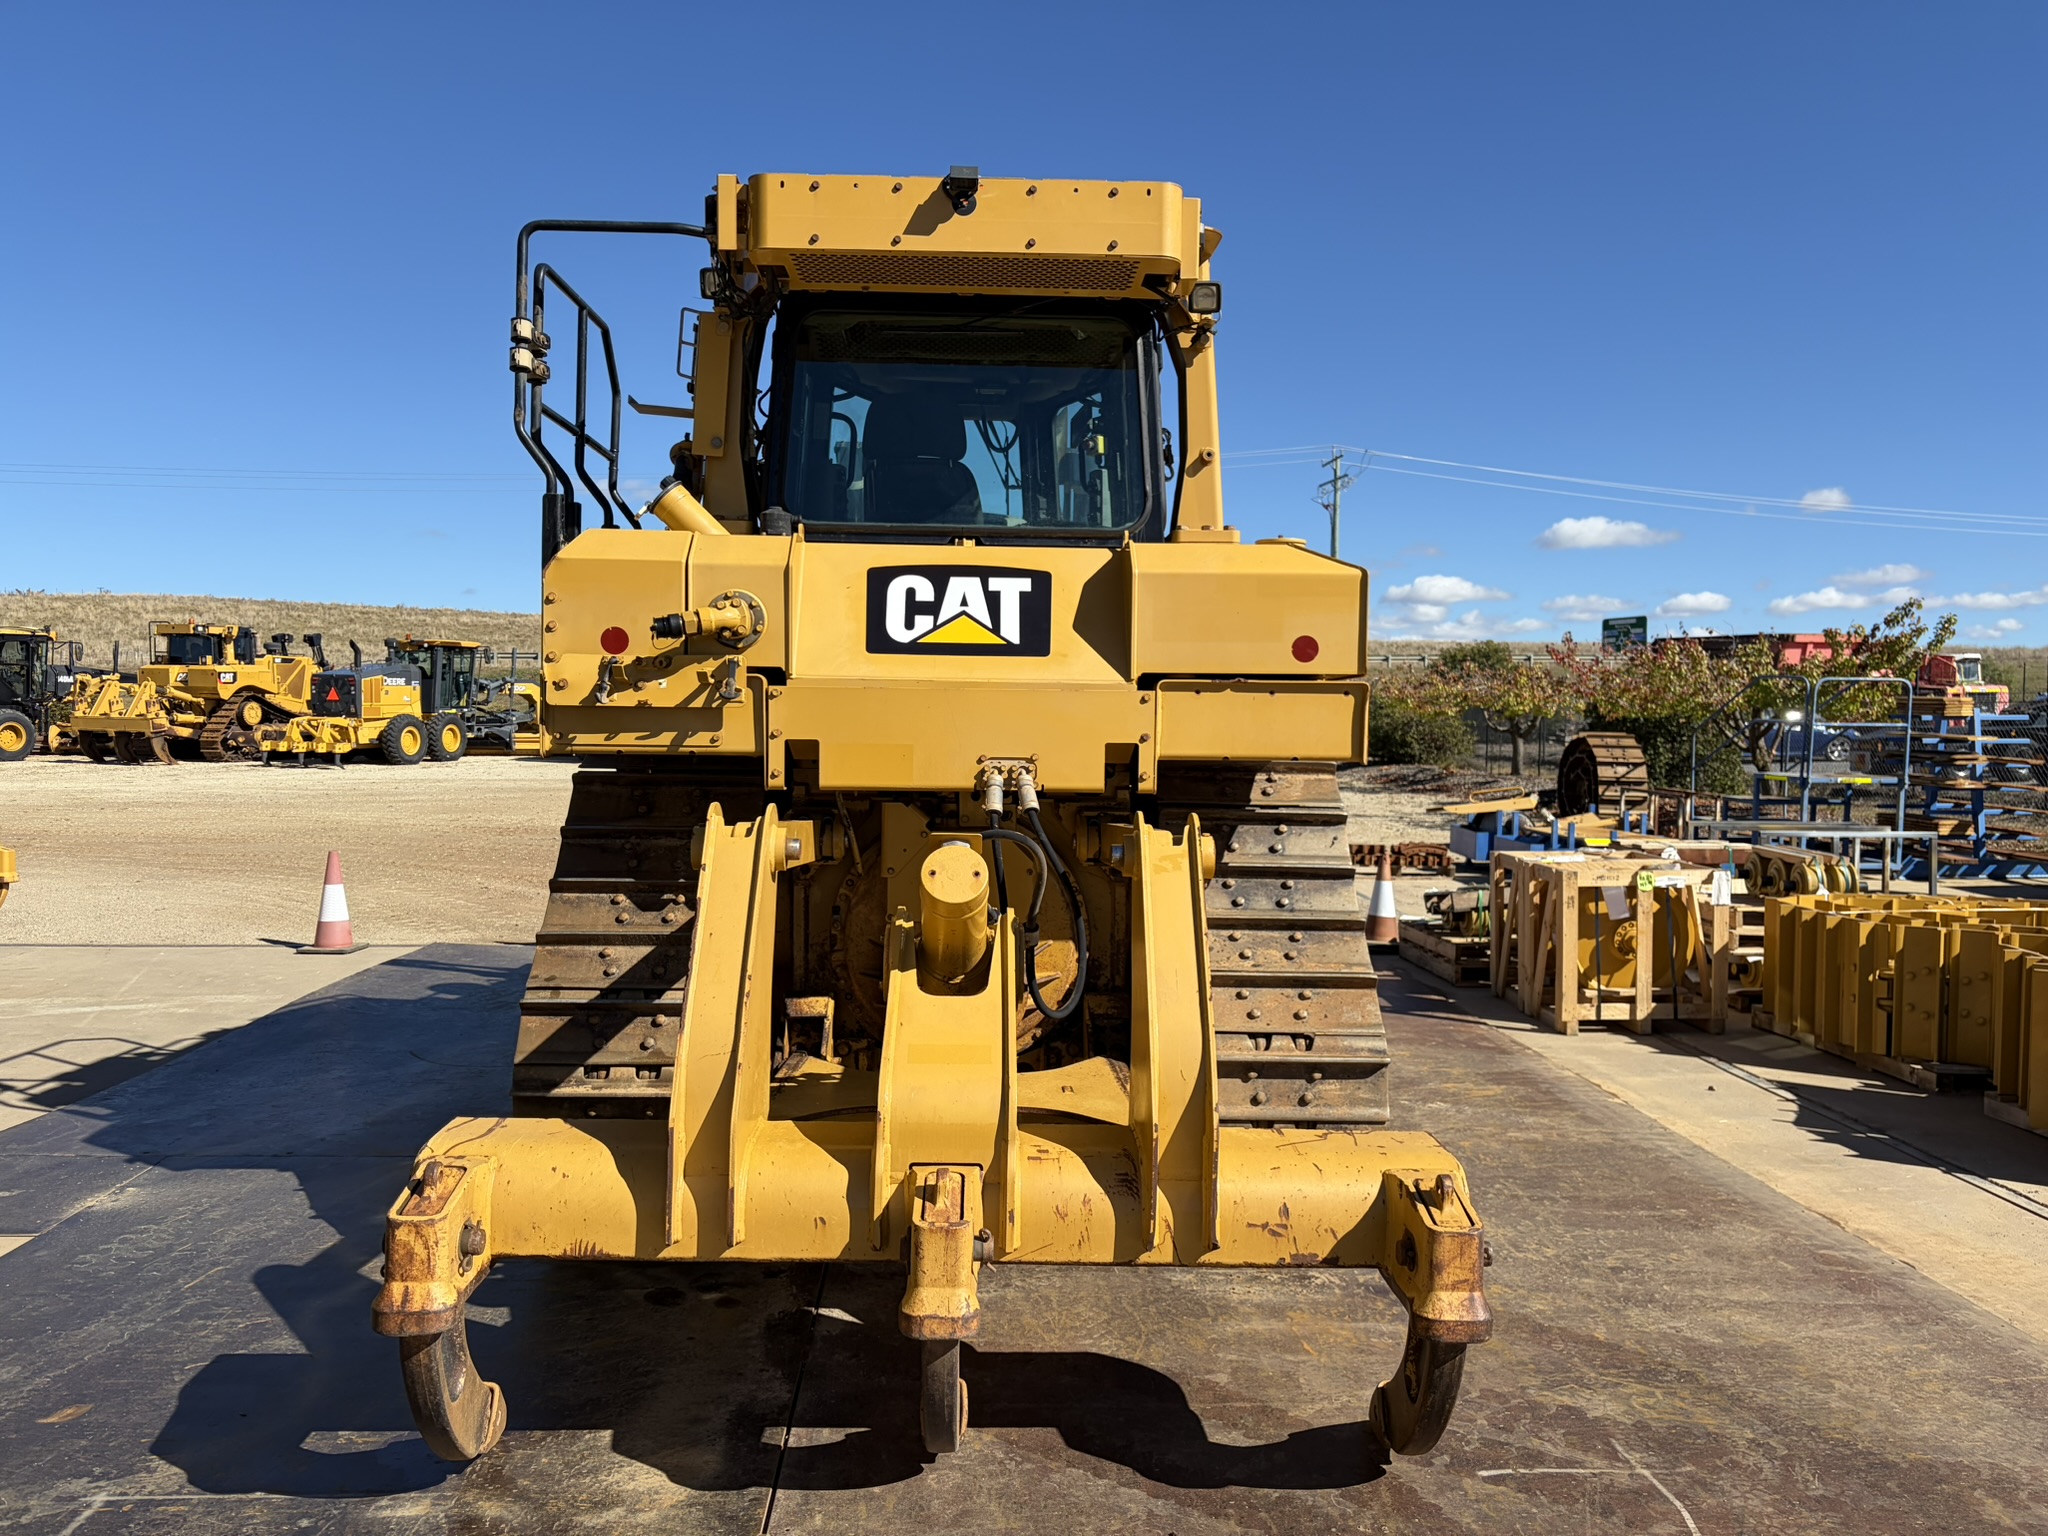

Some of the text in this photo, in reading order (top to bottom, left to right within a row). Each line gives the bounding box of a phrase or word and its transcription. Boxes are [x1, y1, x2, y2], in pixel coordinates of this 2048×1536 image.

[885, 574, 1032, 645] CAT
[220, 673, 234, 683] CAT
[383, 676, 406, 686] DEERE
